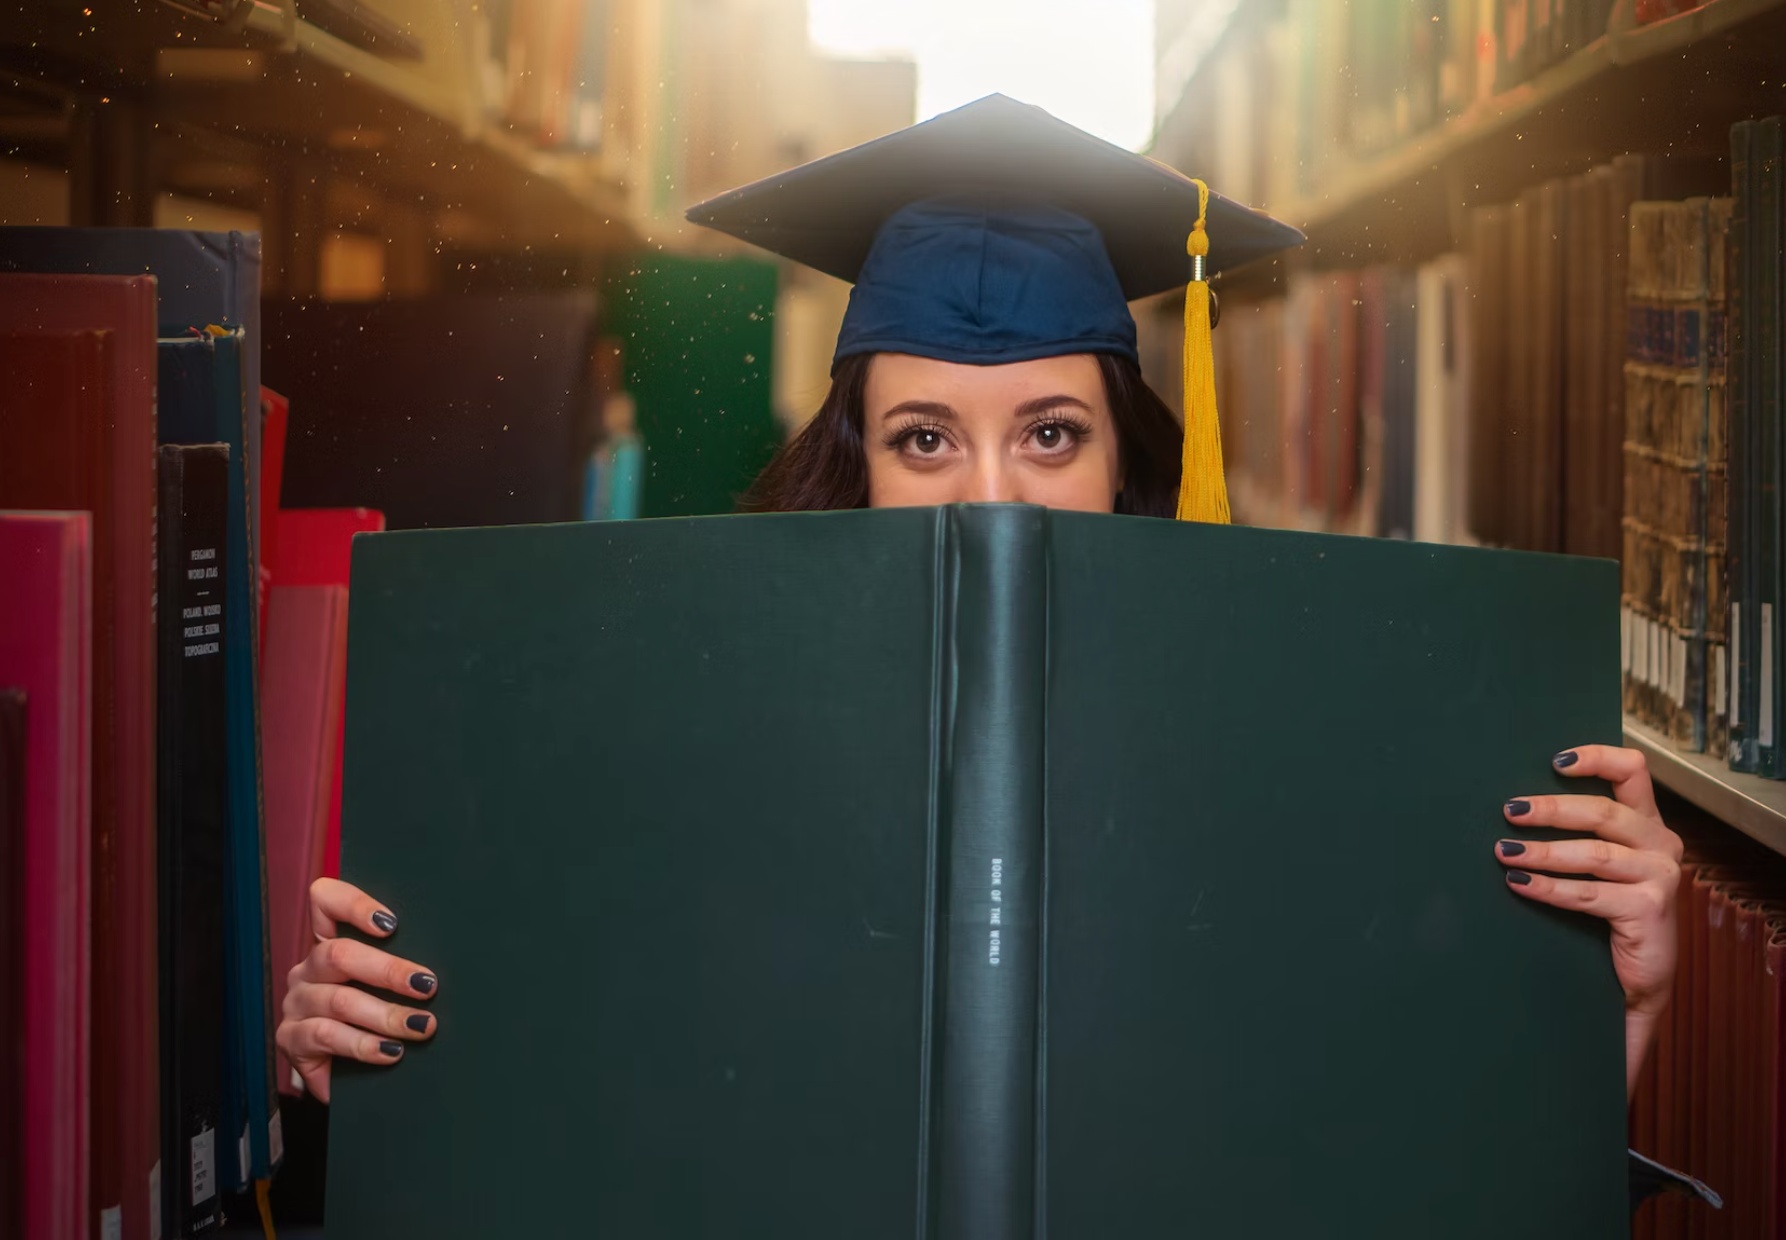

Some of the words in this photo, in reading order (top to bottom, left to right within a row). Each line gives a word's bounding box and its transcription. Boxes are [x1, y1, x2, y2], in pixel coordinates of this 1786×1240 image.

[188, 568, 205, 580] WORLD
[205, 566, 218, 578] ATLAS
[991, 858, 1003, 885] BOOK
[990, 889, 1002, 902] OF
[989, 907, 1001, 925] THE
[989, 930, 1001, 965] WORLD
